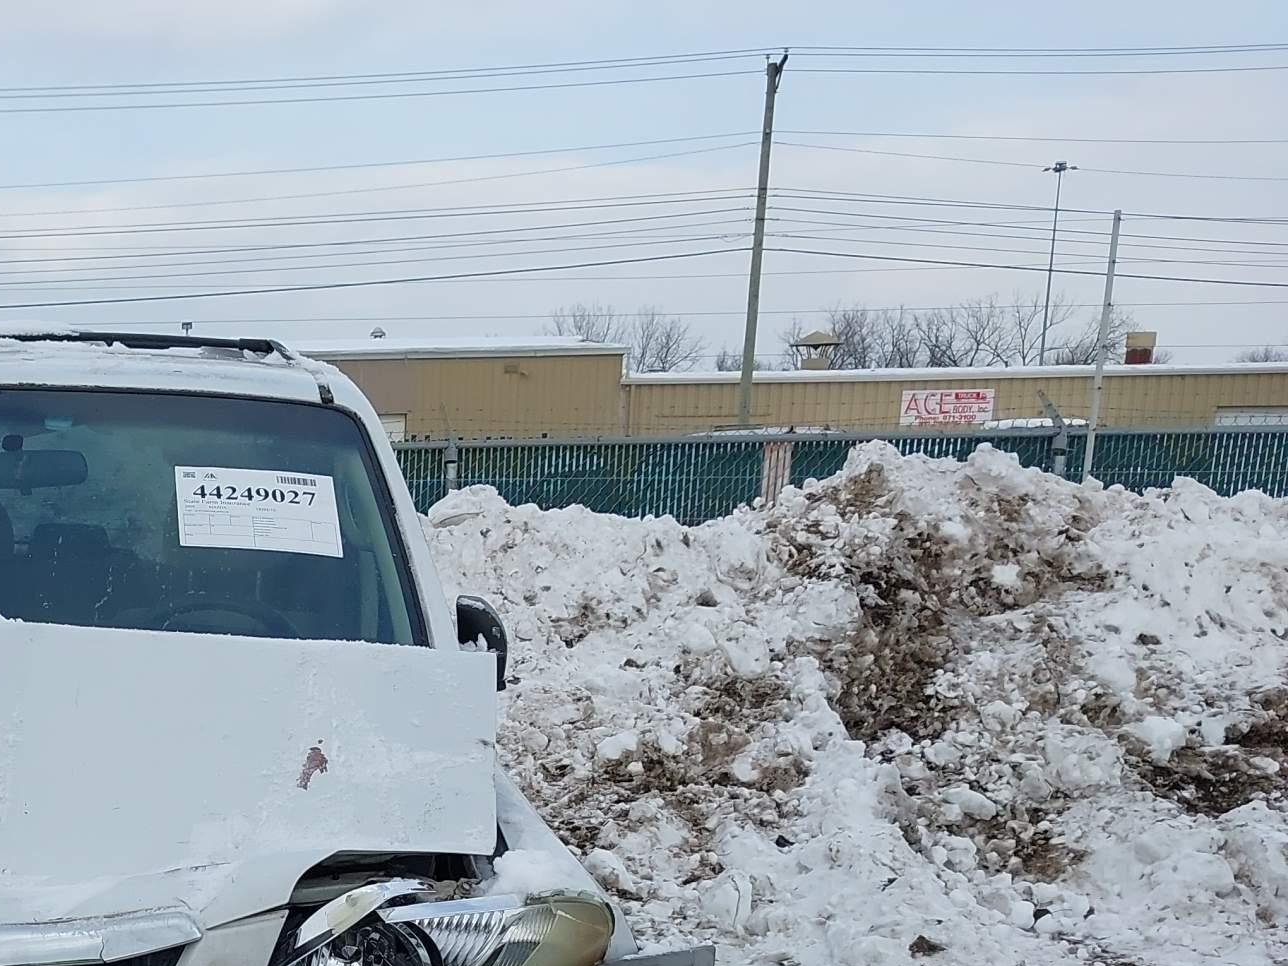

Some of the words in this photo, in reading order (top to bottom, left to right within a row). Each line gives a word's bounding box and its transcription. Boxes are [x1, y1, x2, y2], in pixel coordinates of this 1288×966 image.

[904, 391, 952, 415] ACE
[958, 392, 979, 400] TRUCK
[192, 484, 316, 507] 44249027
